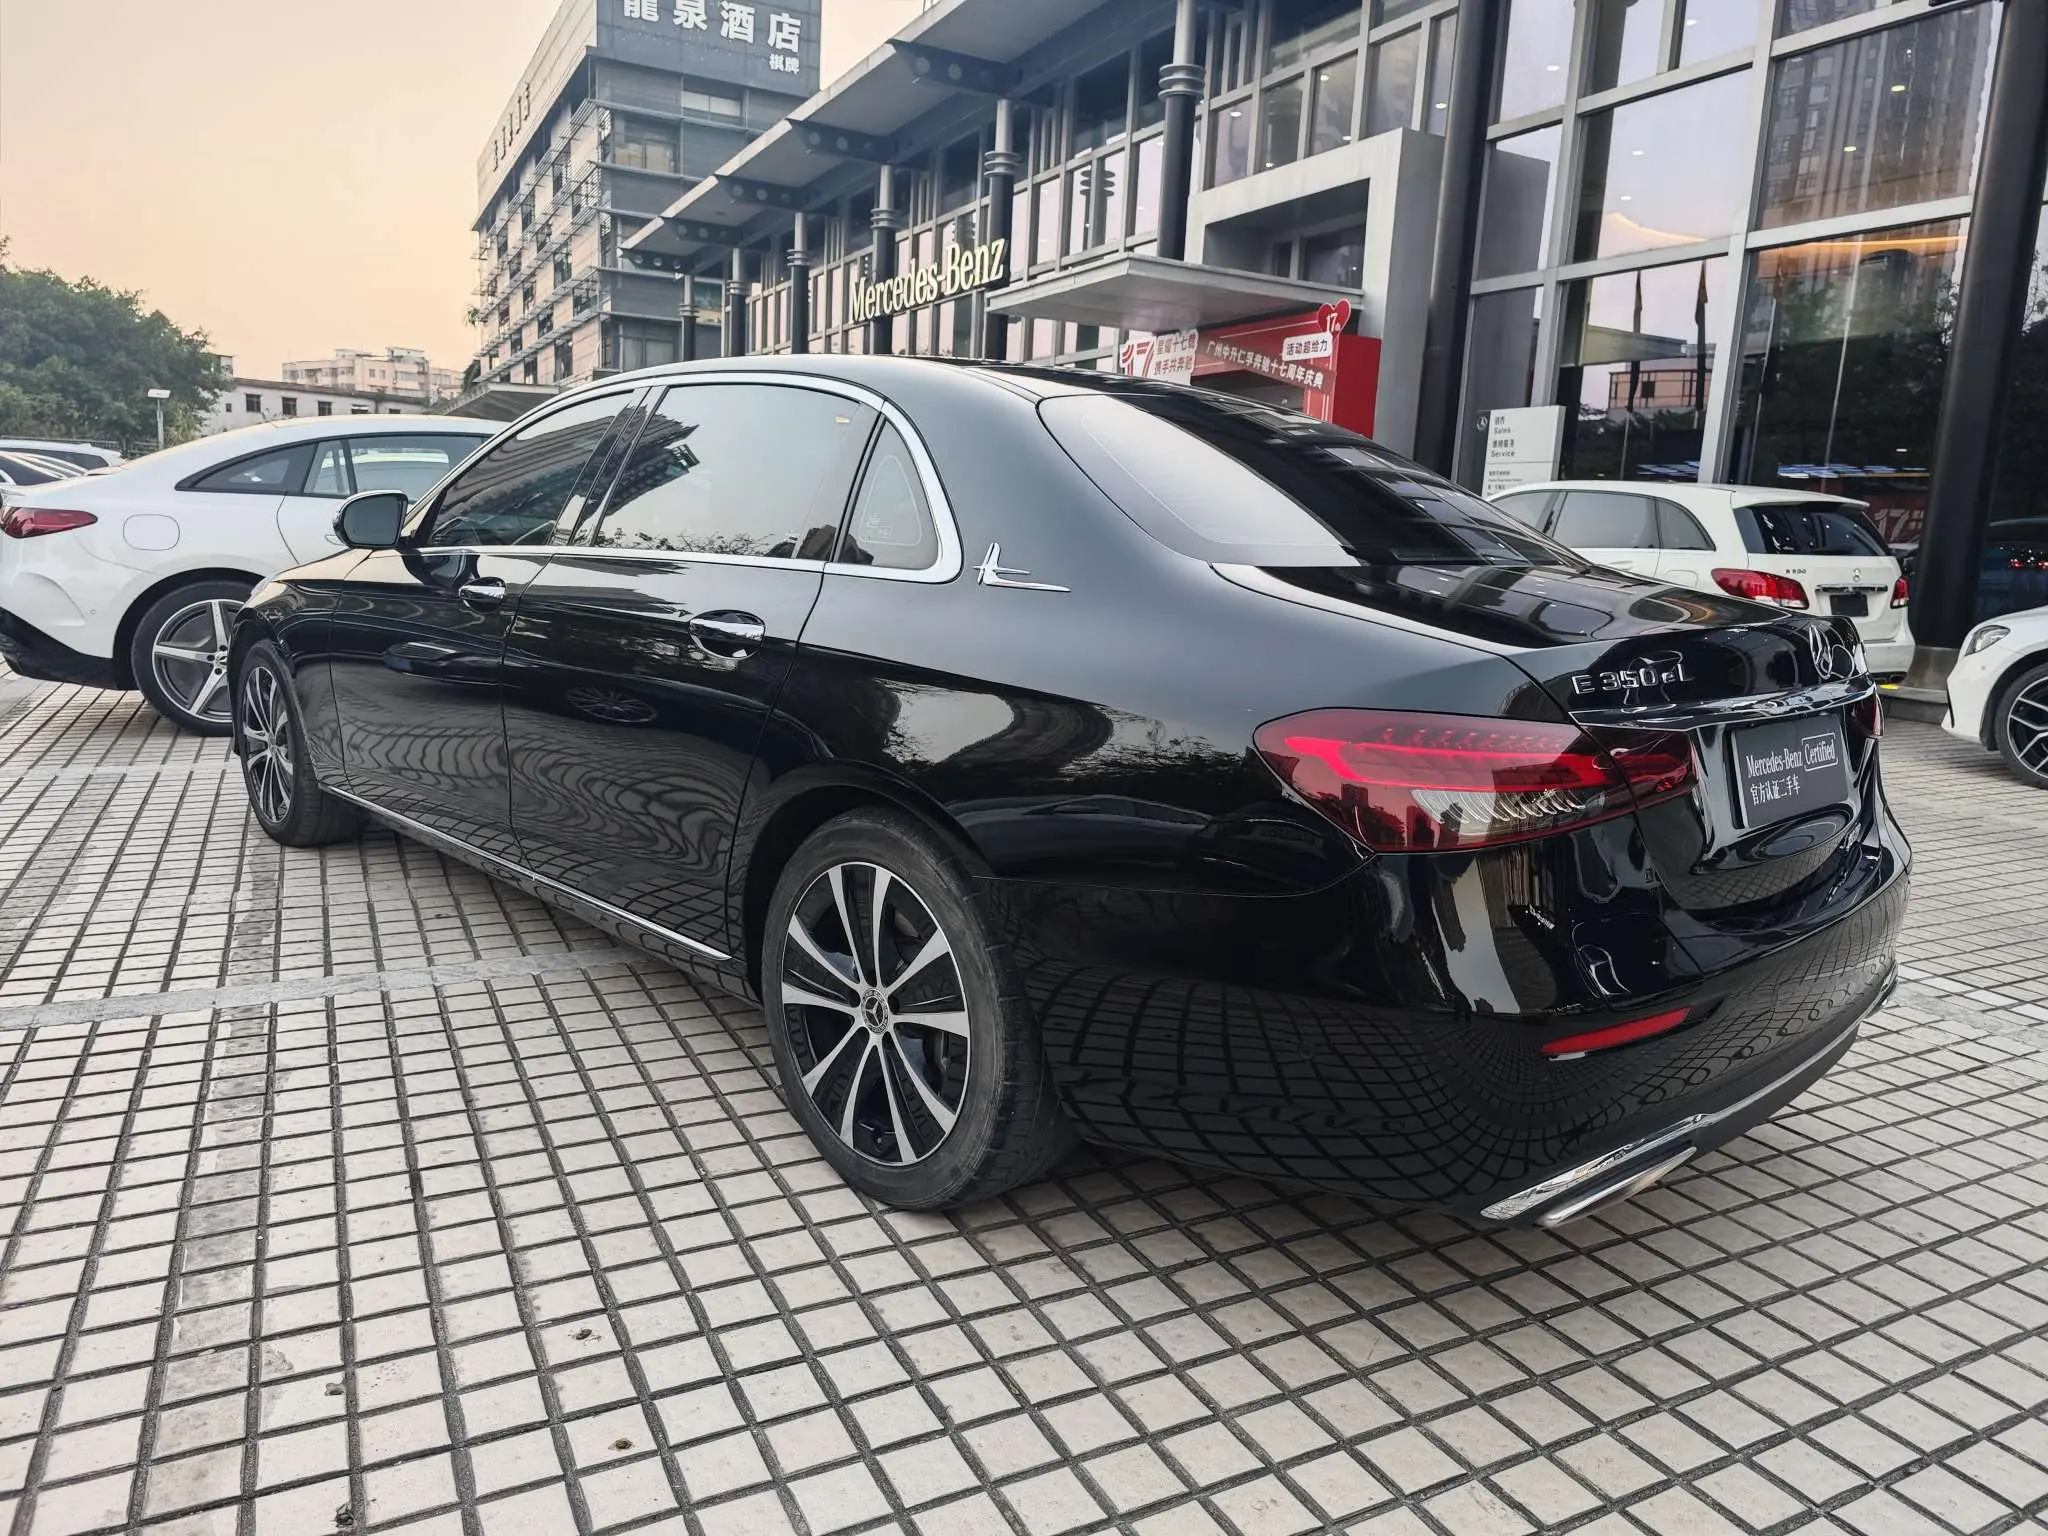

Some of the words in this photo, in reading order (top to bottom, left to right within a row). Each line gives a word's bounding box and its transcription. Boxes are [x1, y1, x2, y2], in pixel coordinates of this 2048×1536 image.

[769, 53, 800, 75] 棋牌
[849, 238, 1005, 325] Mercedes-Benz
[1286, 338, 1328, 356] 活动超给力
[1494, 427, 1511, 435] Sales
[1491, 450, 1515, 458] Service
[1572, 674, 1596, 695] E
[1746, 748, 1803, 778] Mercedes-Benz
[1804, 739, 1836, 765] Certified
[1750, 774, 1800, 806] 官方认证二手车
